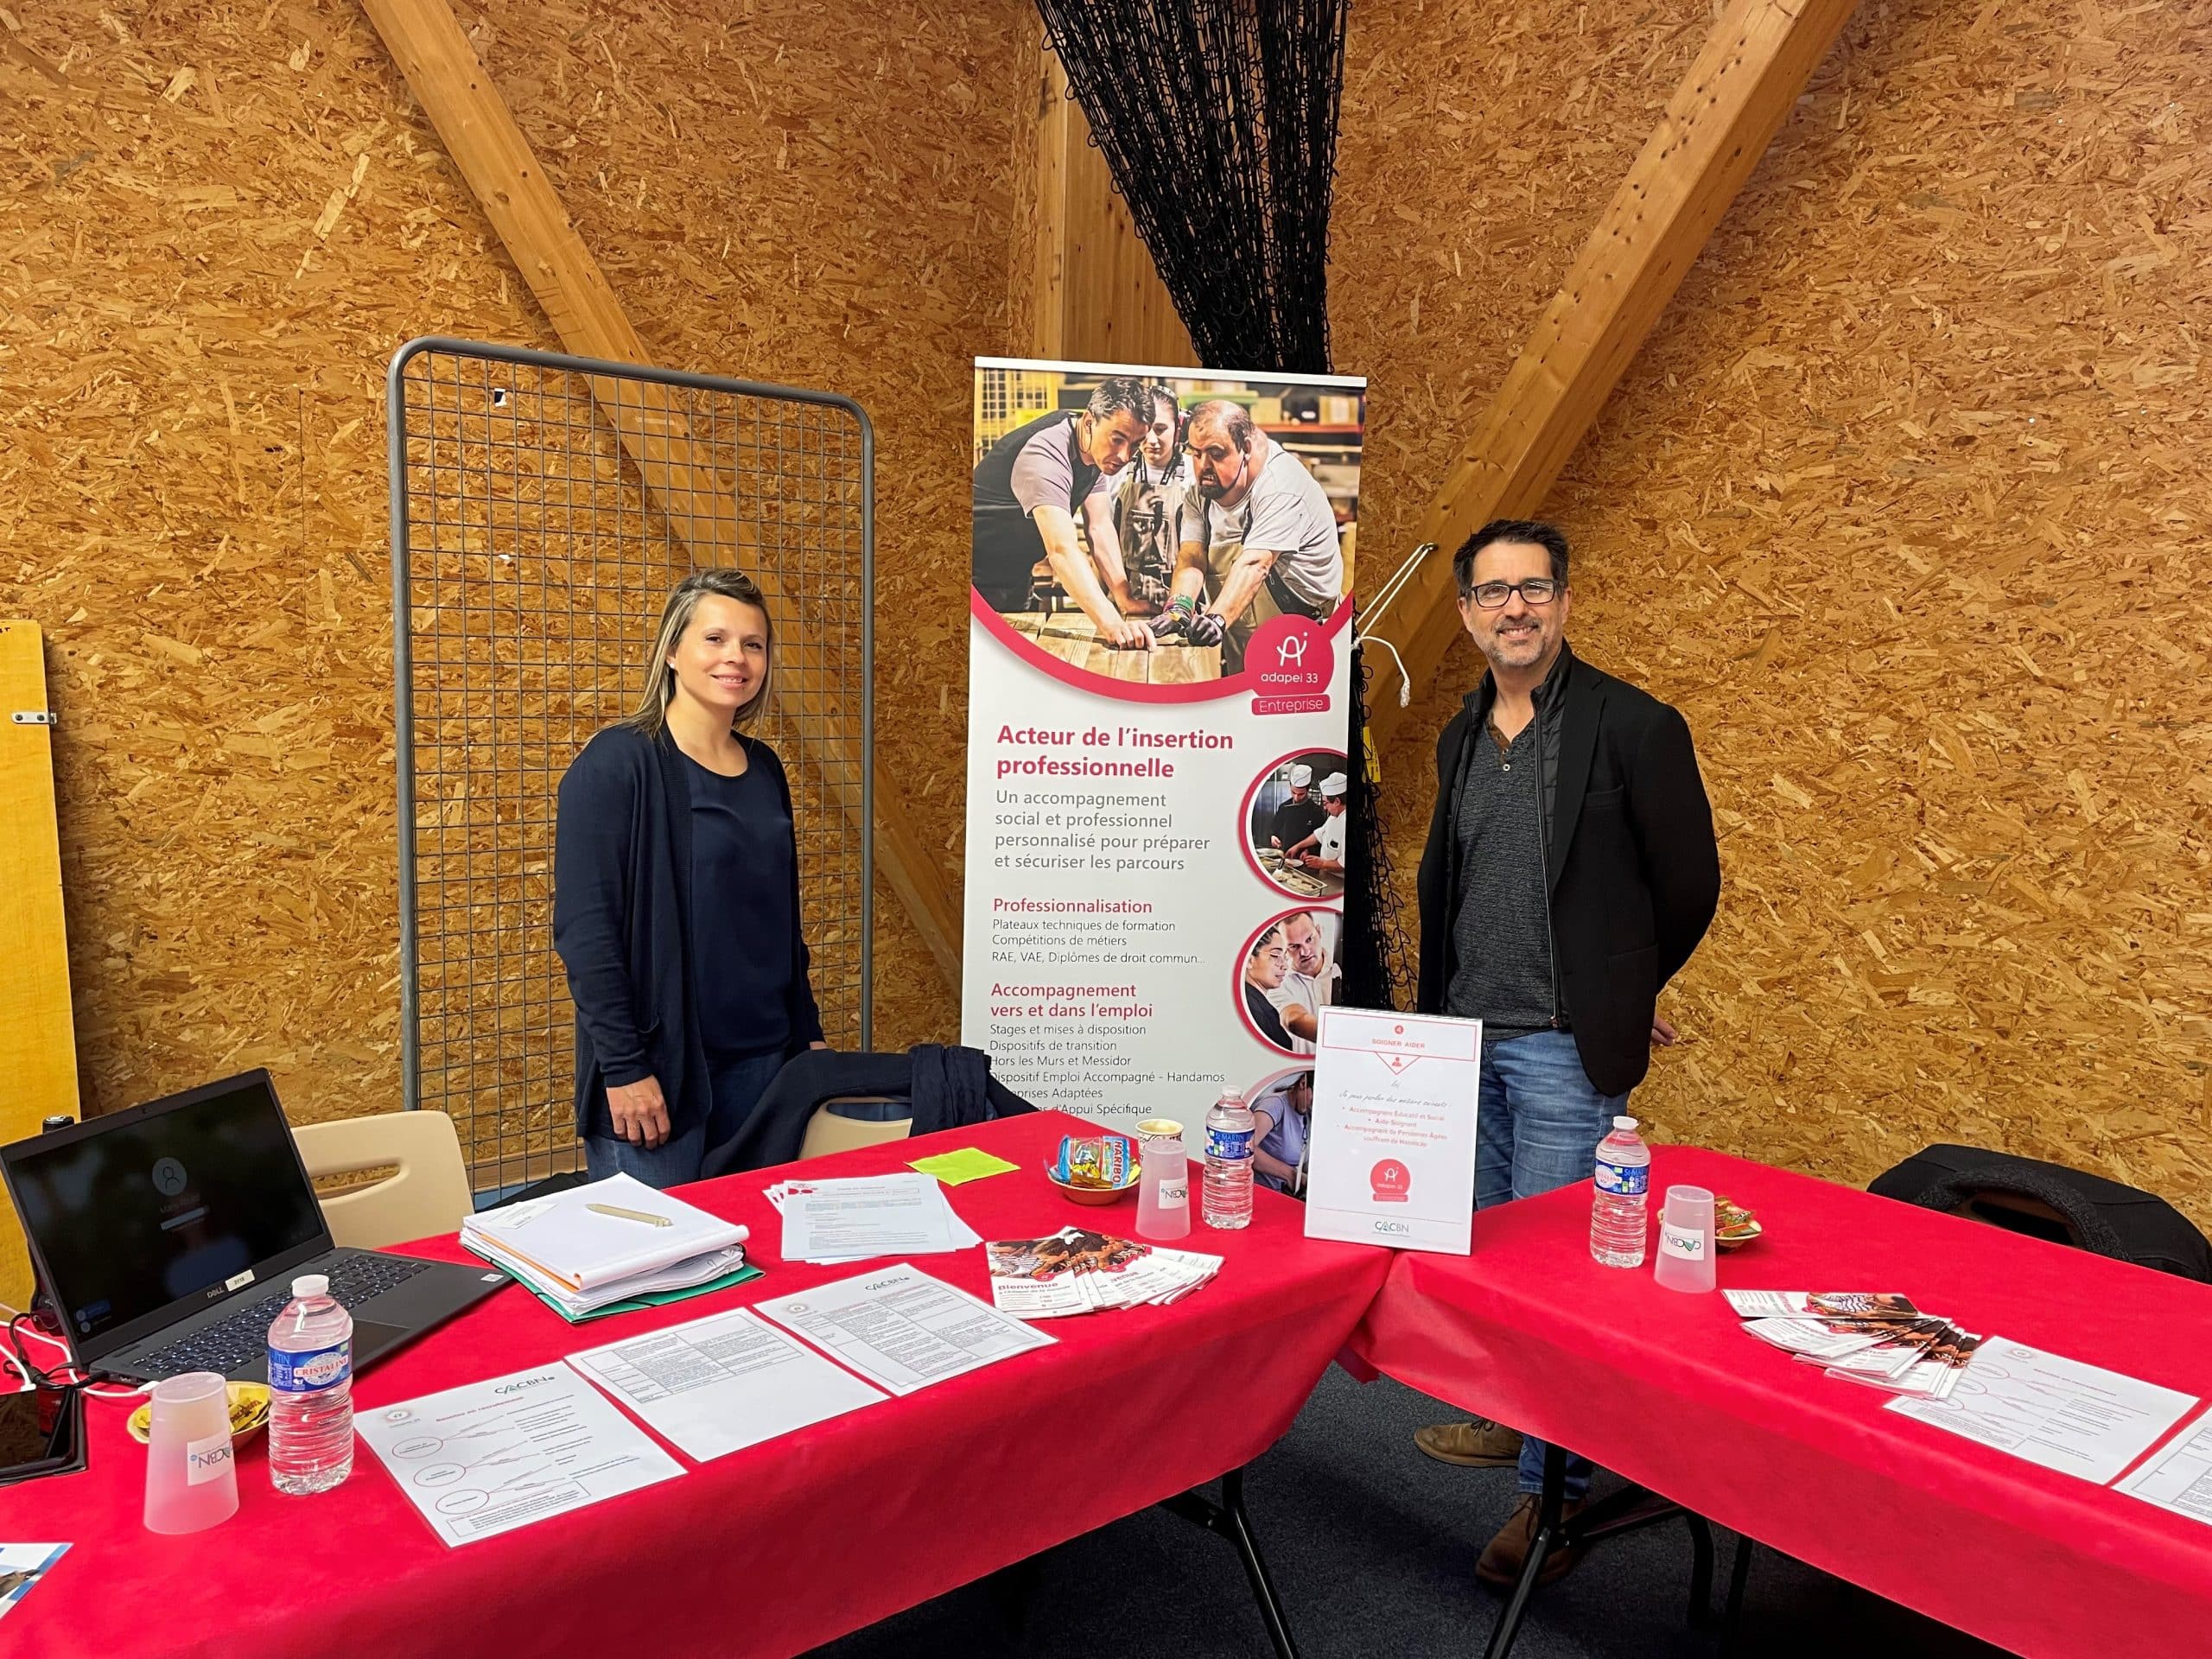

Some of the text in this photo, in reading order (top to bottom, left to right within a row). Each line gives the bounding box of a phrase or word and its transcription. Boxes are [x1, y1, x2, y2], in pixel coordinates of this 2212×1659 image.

[1261, 671, 1319, 685] adapei 33
[1258, 698, 1324, 713] Entreprise
[996, 724, 1234, 749] Acteur de l’insertion
[996, 755, 1174, 779] professionnelle
[995, 789, 1167, 809] Un accompagnement
[995, 811, 1173, 830] social et professionnel
[995, 833, 1211, 853] personnalisé pour préparer
[994, 853, 1185, 873] et sécuriser les parcours
[993, 898, 1153, 913] Professionnalisation
[993, 918, 1176, 933] Plateaux techniques de formation
[992, 934, 1128, 948] Compétitions de métiers
[992, 951, 1017, 964] RAE,
[1020, 952, 1045, 964] VAE,
[1048, 951, 1100, 966] Diplômes
[1103, 952, 1117, 963] de
[1120, 952, 1147, 963] droit
[991, 982, 1137, 1000] Accompagnement
[990, 1002, 1154, 1020] vers et dans l’emploi
[989, 1024, 1147, 1039] Stages et mises à disposition
[989, 1039, 1117, 1053] Dispositifs de transition
[991, 1055, 1132, 1067] Hors les Murs et Messidor
[1043, 1071, 1080, 1084] Emploi
[1084, 1071, 1155, 1086] Accompagné
[1167, 1071, 1225, 1083] Handamos
[1014, 1088, 1103, 1102] prises Adaptées
[1096, 1103, 1153, 1117] Spécifique
[1112, 1141, 1123, 1184] HARIBO
[207, 1286, 225, 1299] DELL
[997, 1281, 1058, 1291] Bienvenue
